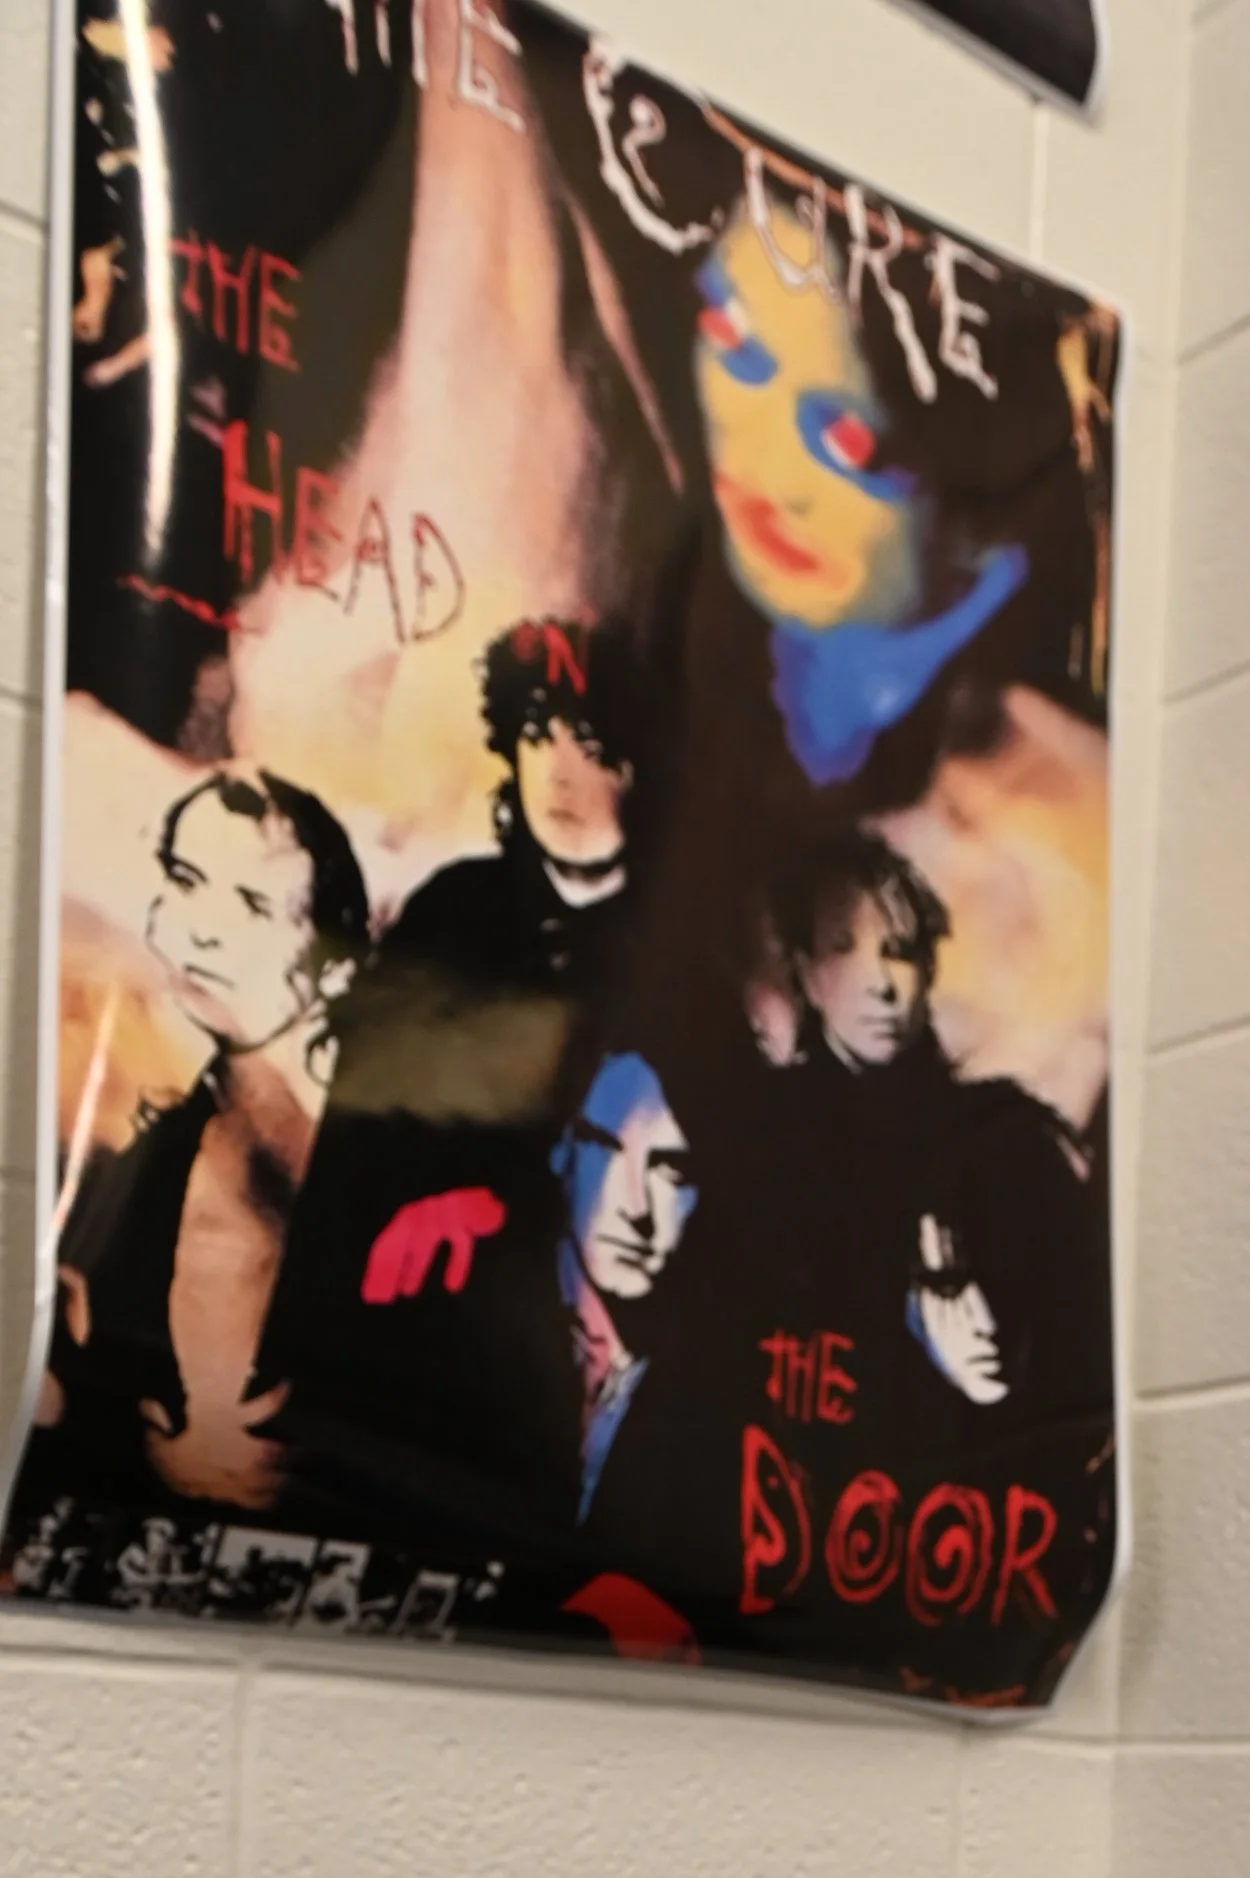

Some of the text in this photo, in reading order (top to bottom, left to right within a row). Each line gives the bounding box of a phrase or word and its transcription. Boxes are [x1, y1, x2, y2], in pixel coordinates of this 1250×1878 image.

[170, 228, 300, 373] THE
[582, 38, 1000, 402] CURE
[220, 420, 466, 645] HEAD
[758, 1328, 857, 1424] THE
[738, 1422, 1058, 1628] DOOR
